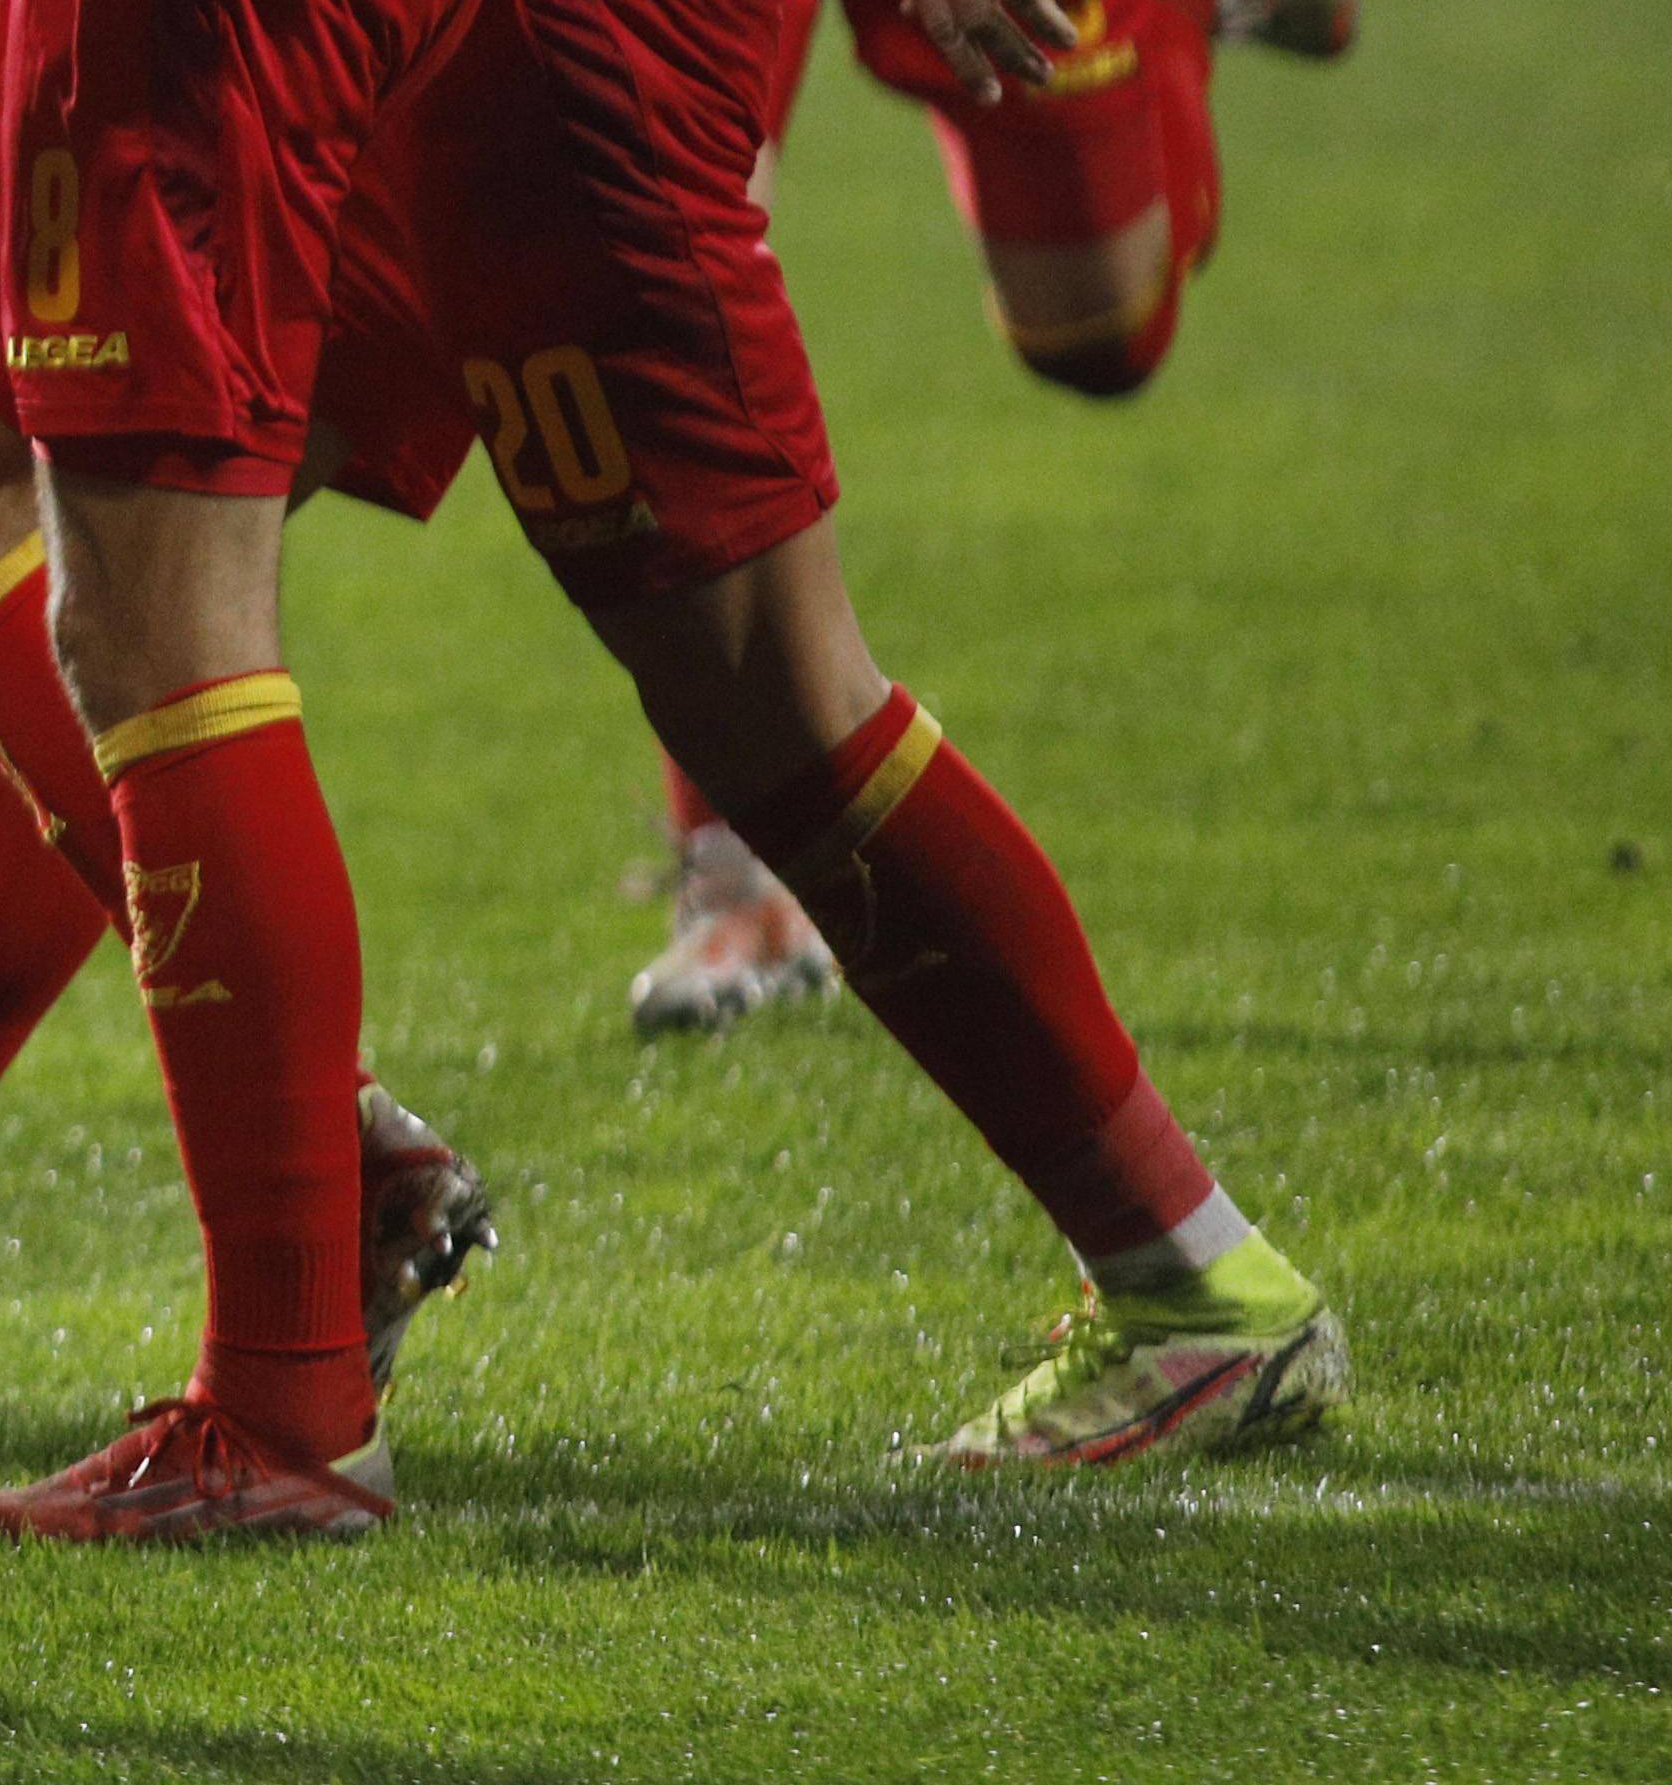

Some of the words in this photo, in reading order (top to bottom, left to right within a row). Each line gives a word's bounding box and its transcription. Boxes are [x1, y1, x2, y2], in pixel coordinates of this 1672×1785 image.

[28, 148, 81, 324] 8
[7, 332, 130, 370] LEGEA
[462, 343, 632, 509] 20
